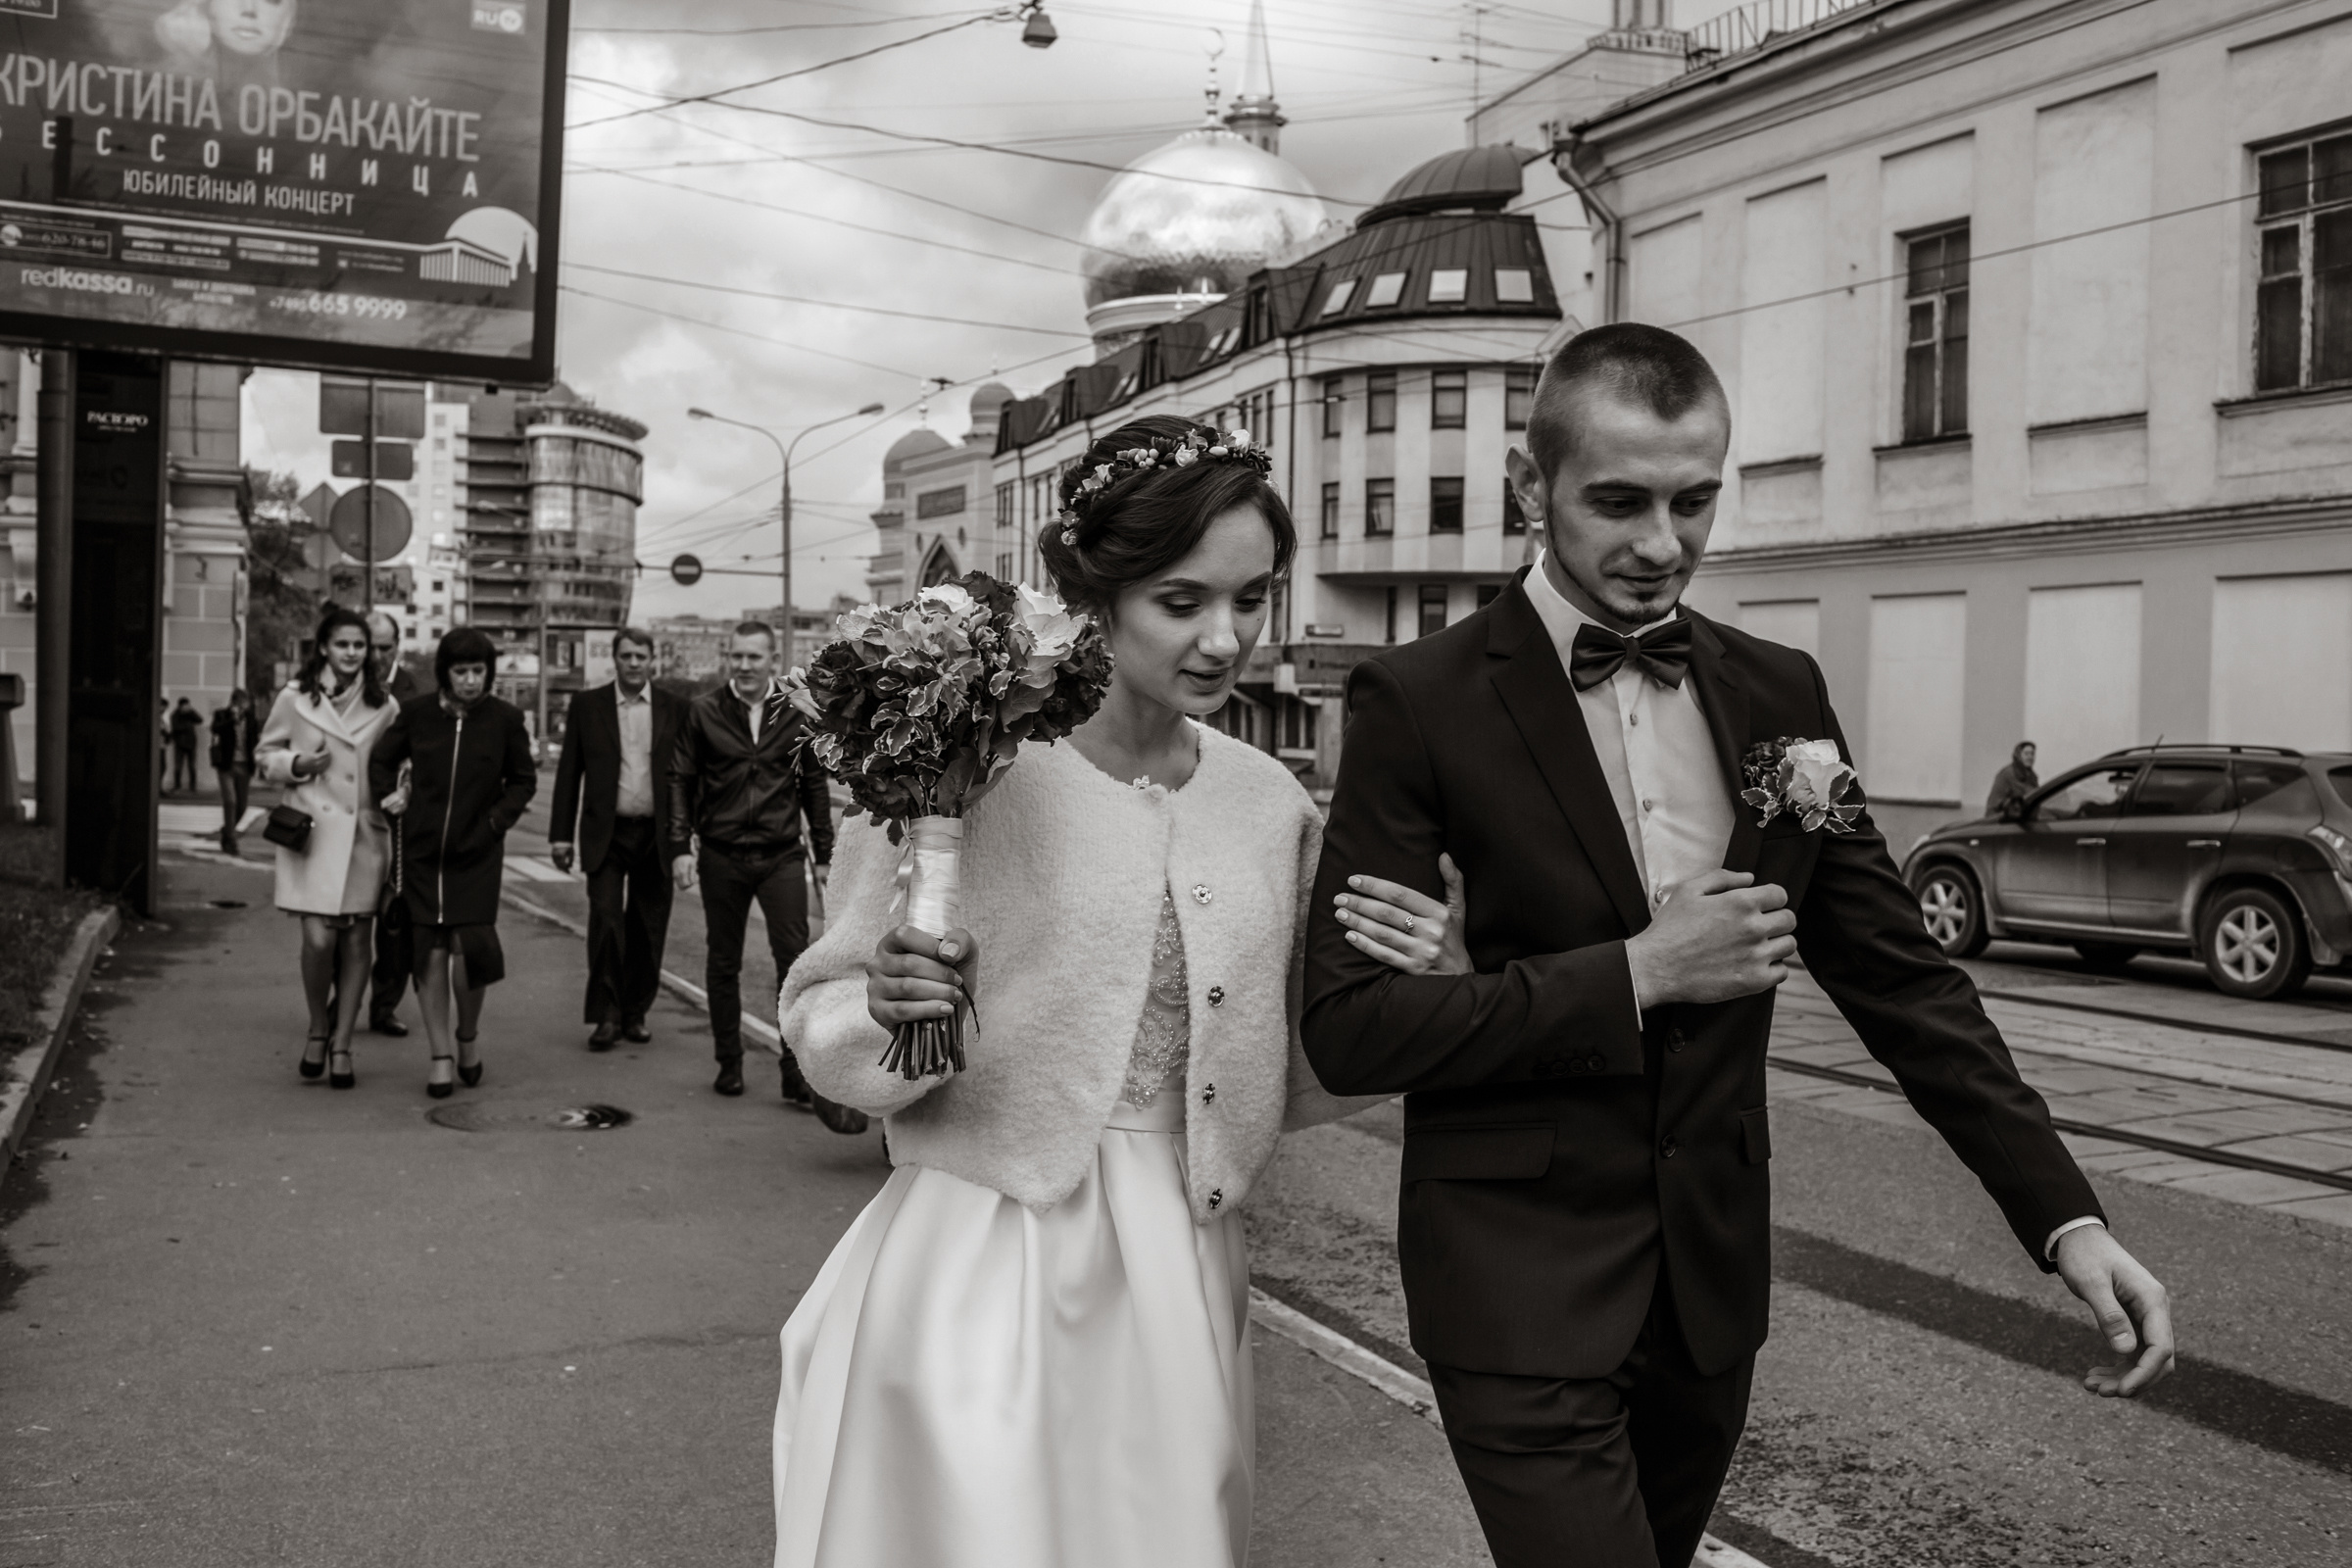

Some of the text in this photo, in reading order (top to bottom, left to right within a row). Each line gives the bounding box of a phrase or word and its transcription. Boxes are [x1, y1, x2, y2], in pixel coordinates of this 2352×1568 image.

[0, 120, 478, 198] ЕССОННИЦА
[238, 83, 481, 163] ОРБАКАЙТЕ
[122, 169, 356, 216] ЮБИЛЕЙНЫЙ КОНЦЕРТ
